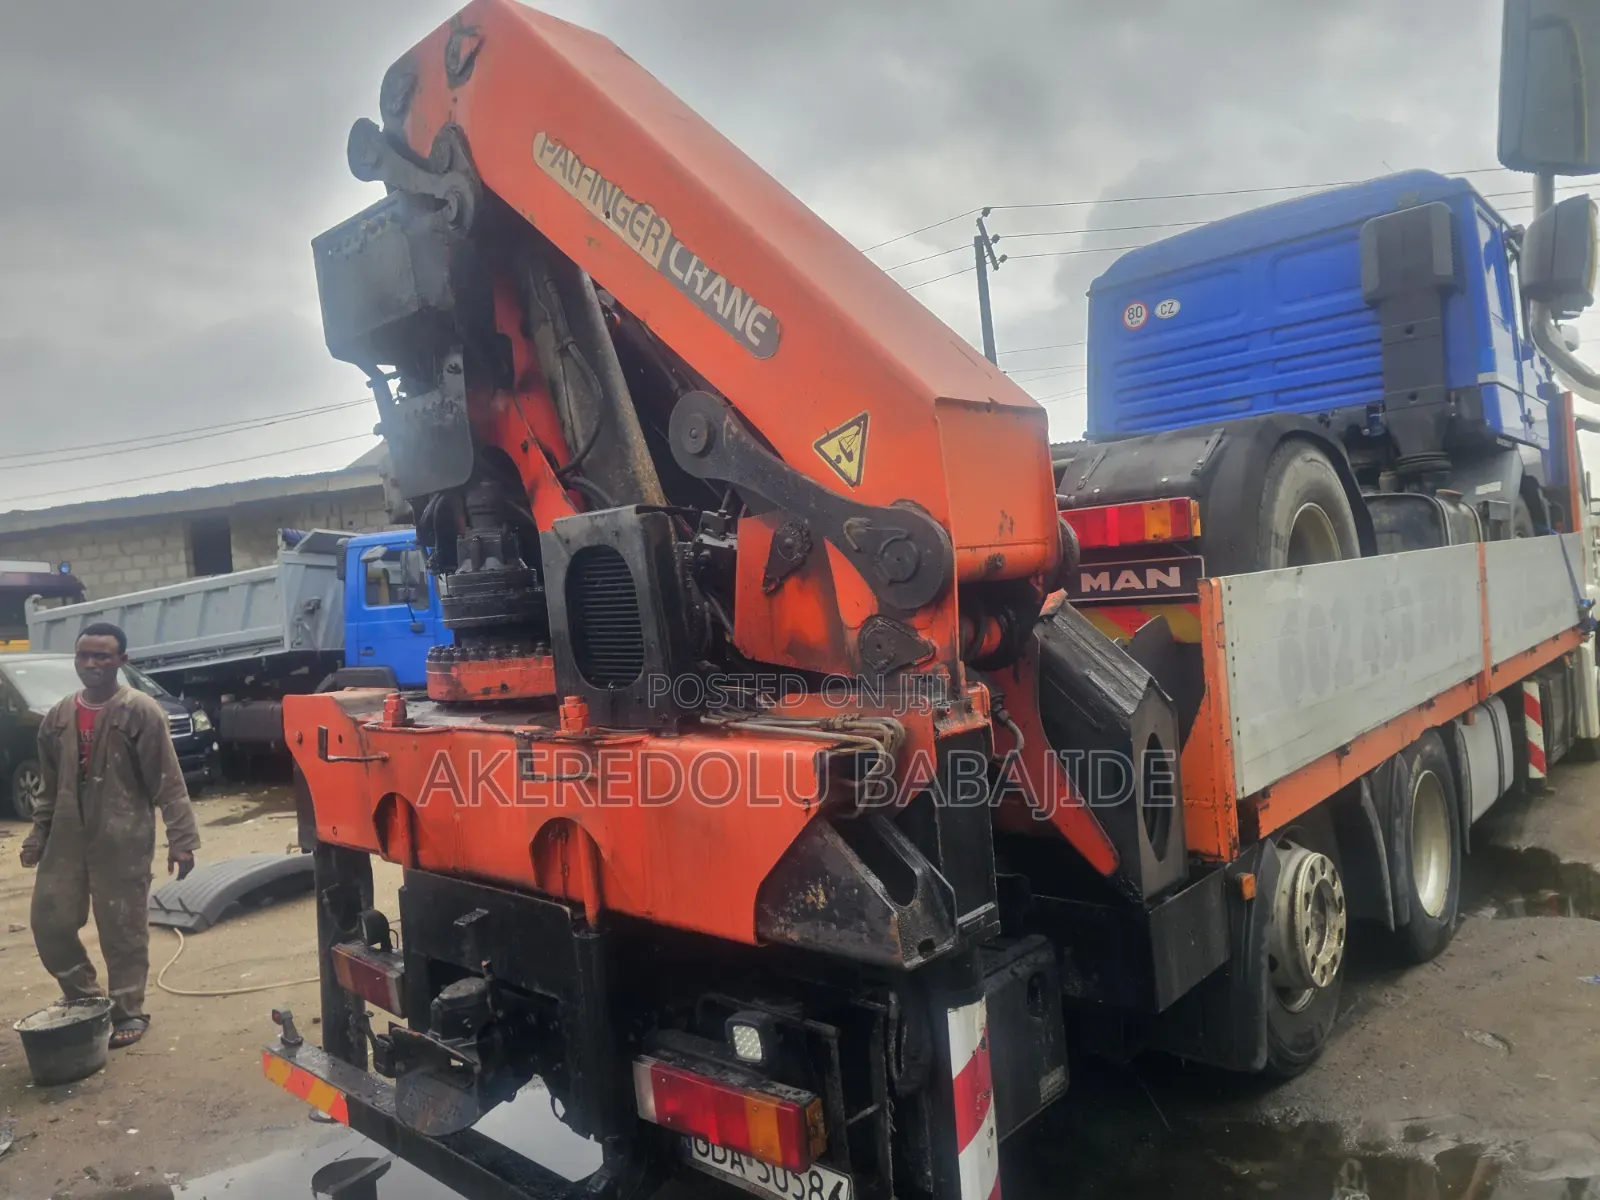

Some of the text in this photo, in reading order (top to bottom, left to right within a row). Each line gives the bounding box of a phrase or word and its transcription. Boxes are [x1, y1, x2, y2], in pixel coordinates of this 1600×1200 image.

[669, 241, 773, 347] CRANE
[1127, 305, 1143, 320] 80
[1160, 302, 1174, 316] CZ
[1080, 566, 1181, 593] MAN
